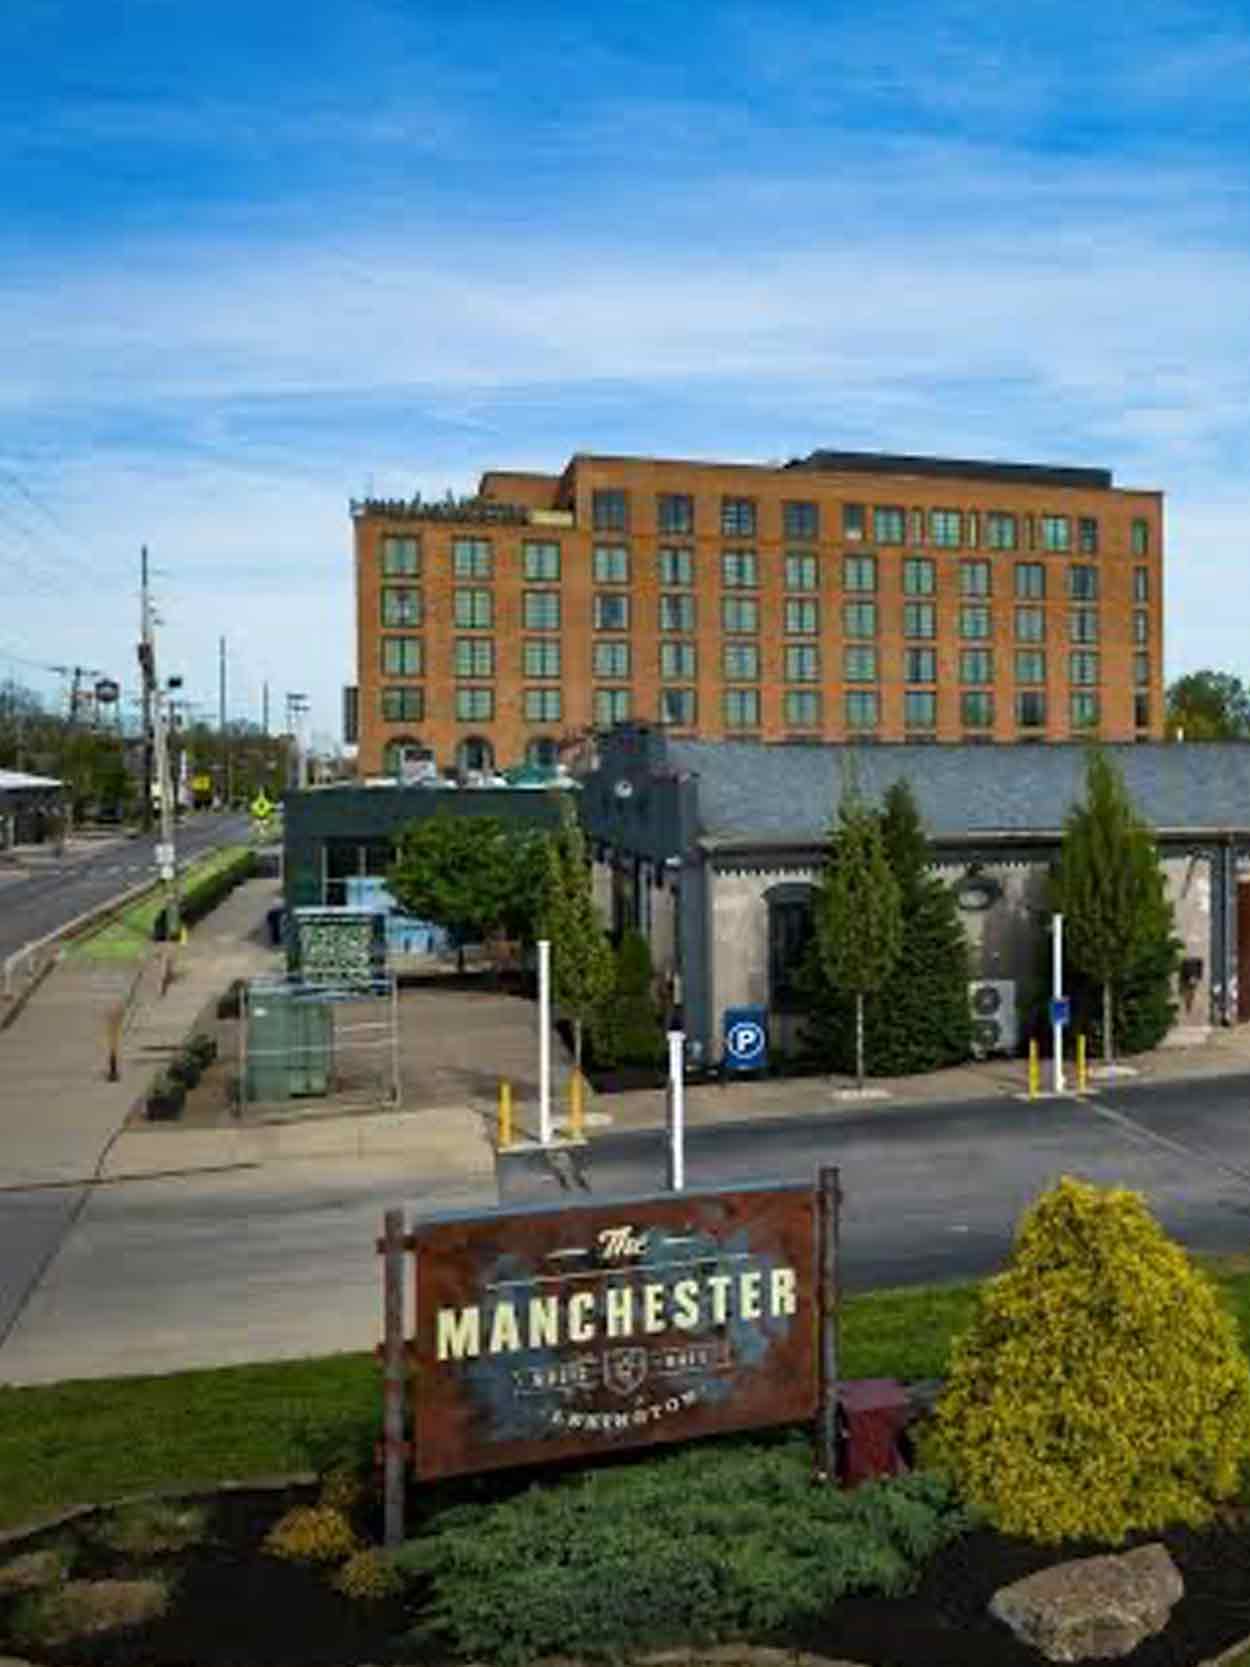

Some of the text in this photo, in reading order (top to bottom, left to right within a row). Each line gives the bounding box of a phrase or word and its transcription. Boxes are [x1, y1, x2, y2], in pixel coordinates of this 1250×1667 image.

[737, 1029, 757, 1052] P
[598, 1225, 648, 1259] The
[437, 1268, 797, 1361] MANCHESTER
